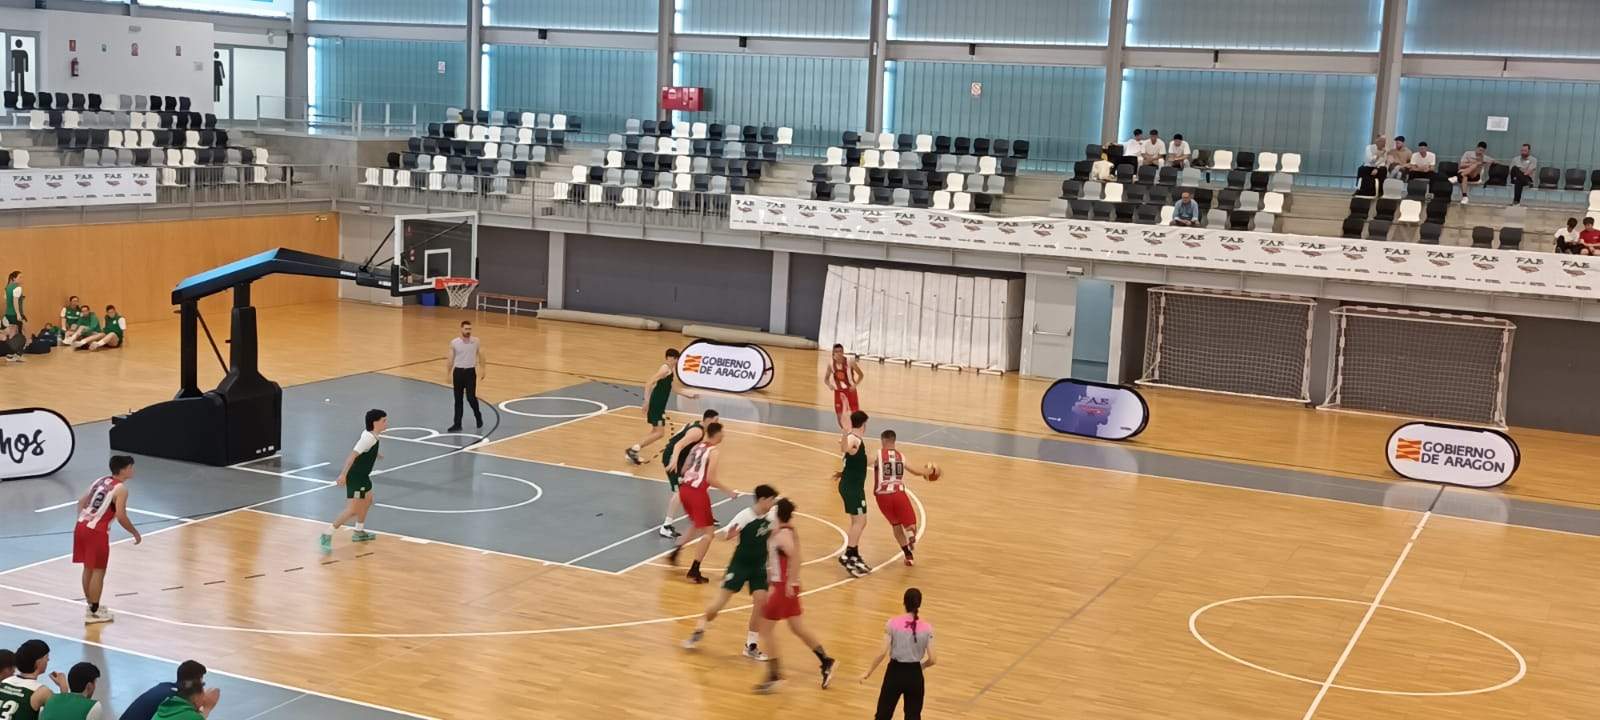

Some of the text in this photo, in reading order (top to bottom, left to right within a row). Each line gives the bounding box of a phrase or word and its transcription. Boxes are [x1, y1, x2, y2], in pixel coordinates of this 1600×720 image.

[702, 356, 751, 369] GOBIERNO
[700, 366, 712, 375] DE
[1423, 442, 1495, 459] GOBIERNO
[1421, 453, 1439, 464] DE
[882, 461, 904, 476] 30
